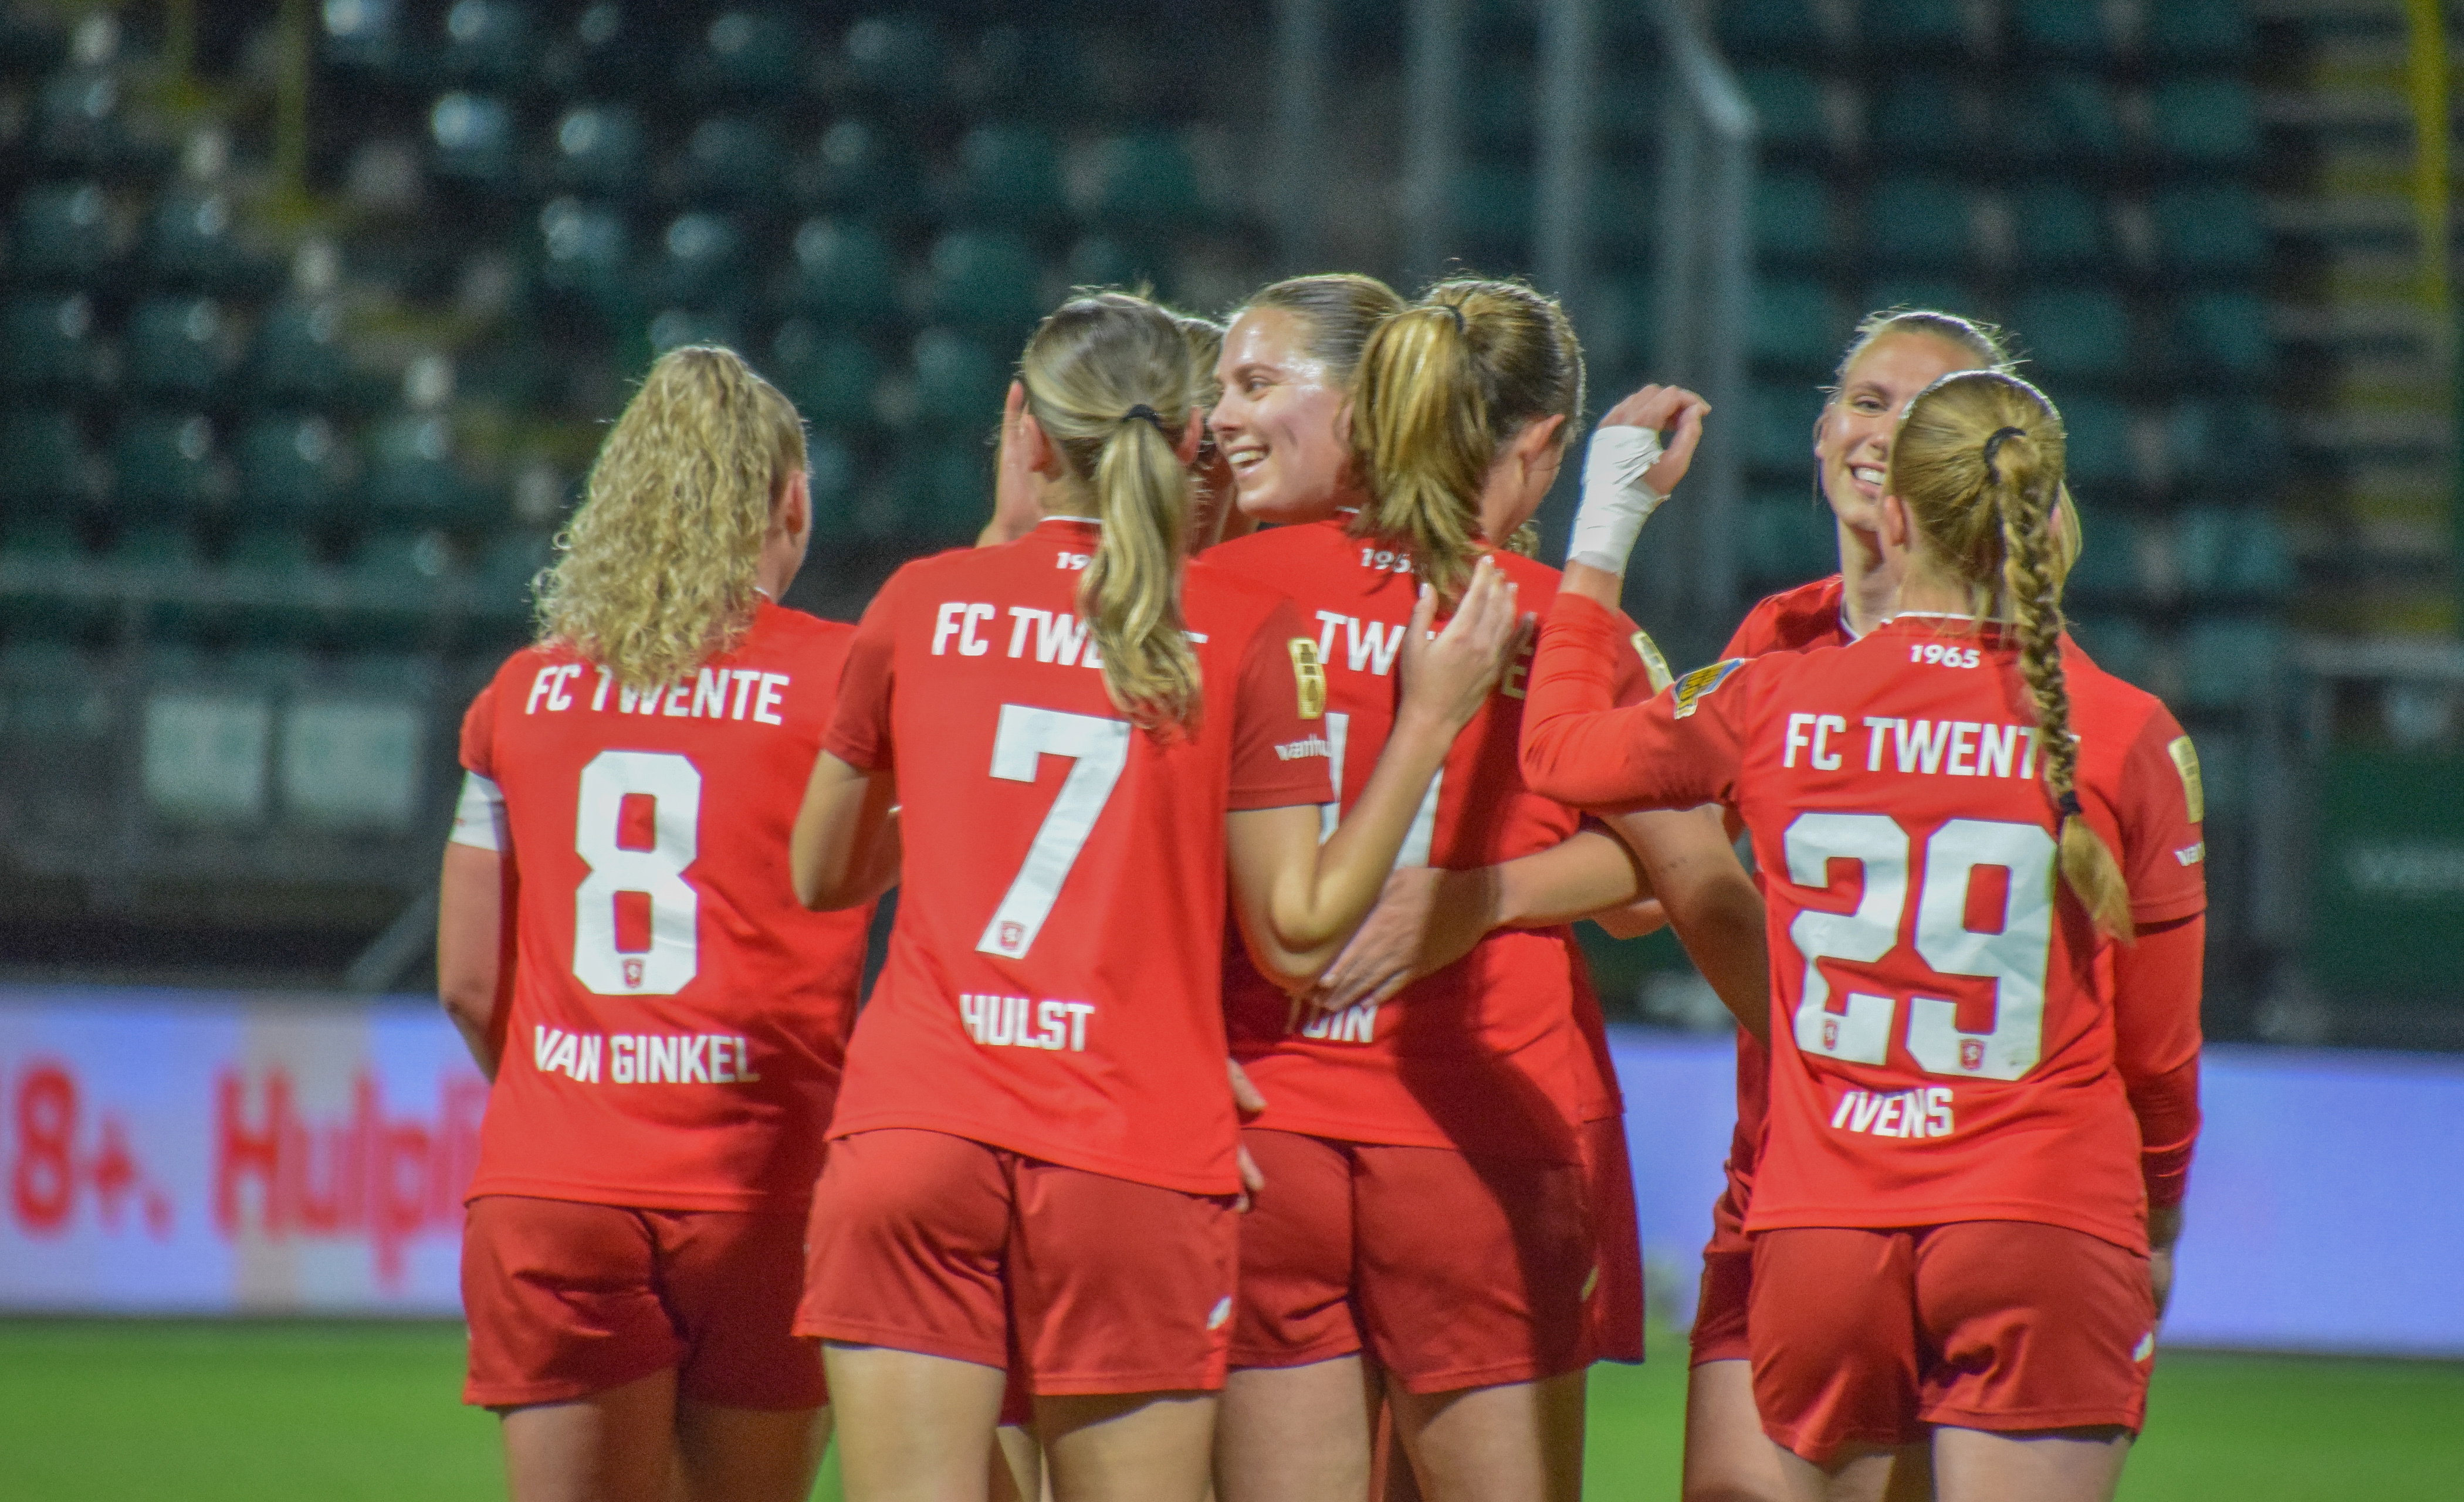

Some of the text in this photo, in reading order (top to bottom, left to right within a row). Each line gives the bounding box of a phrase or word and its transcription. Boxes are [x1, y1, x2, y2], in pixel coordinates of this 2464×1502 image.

[1056, 551, 1094, 571] 19
[931, 602, 996, 656] FC
[1910, 643, 1981, 669] 1965
[525, 664, 582, 715] FC
[1783, 713, 2080, 779] FC TWENT
[974, 703, 1132, 959] 7
[572, 750, 702, 995] 8
[1783, 812, 2058, 1081] 29
[959, 994, 1096, 1052] HULST
[534, 1025, 761, 1084] VAN GINKEL
[1831, 1087, 1955, 1138] IVENS
